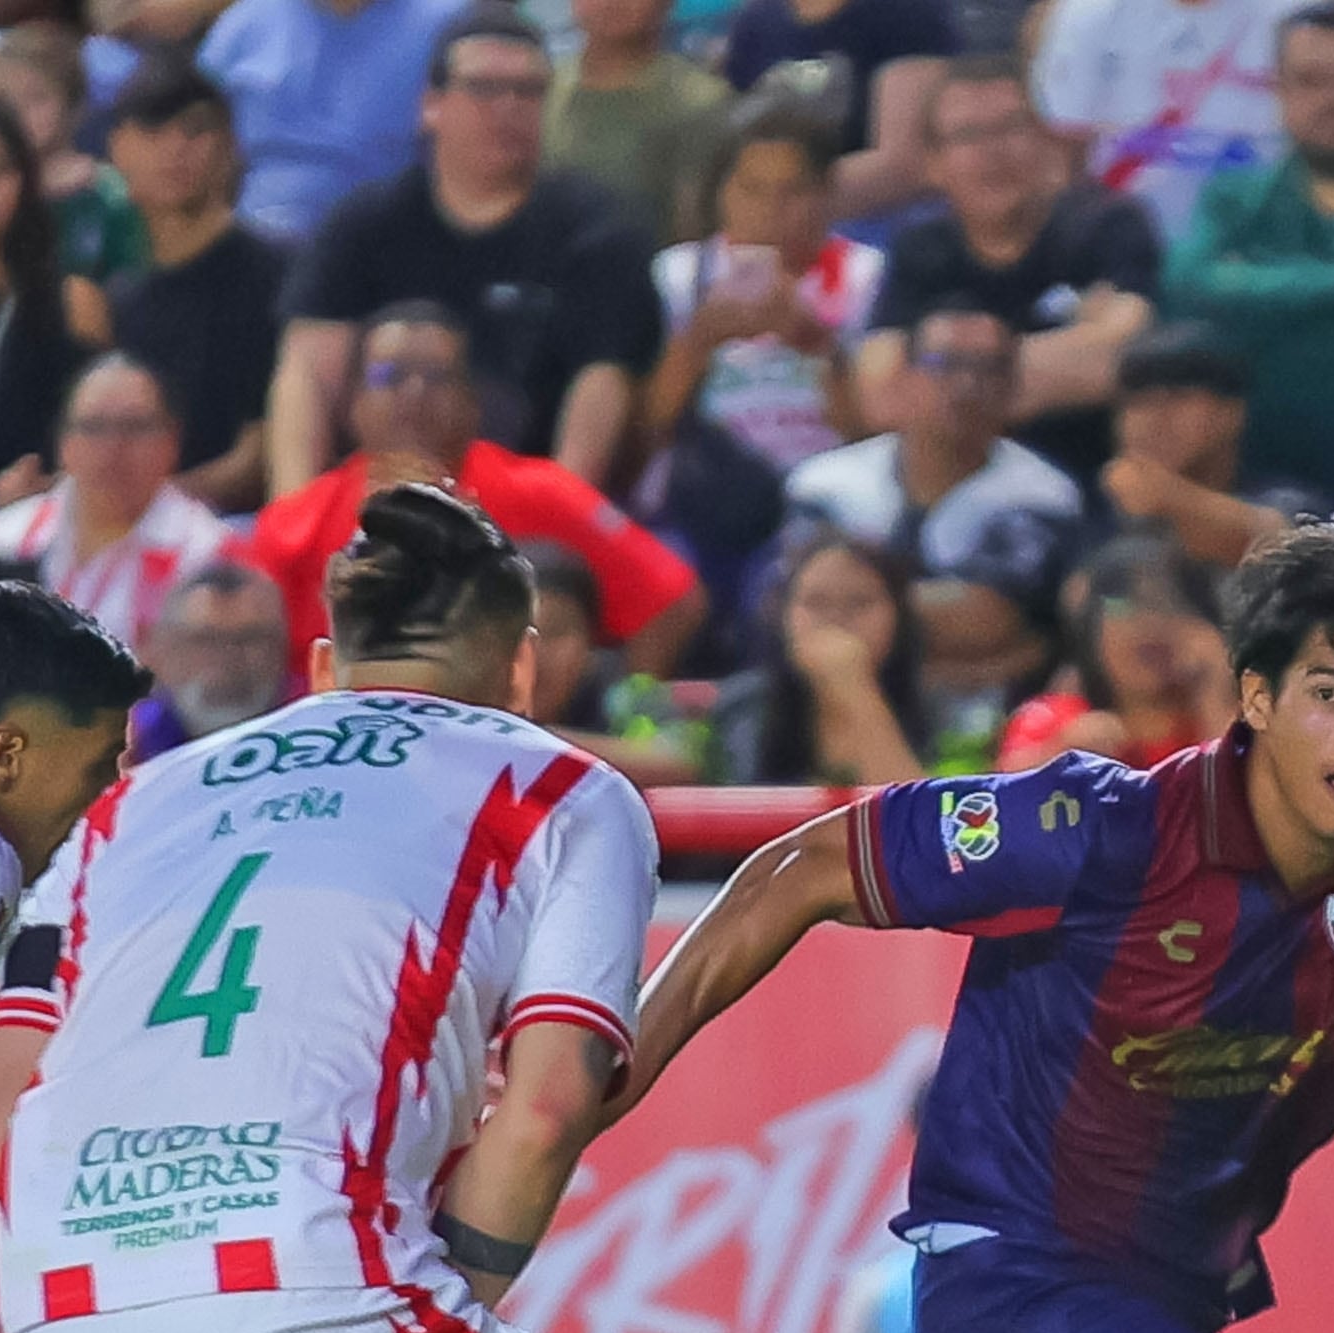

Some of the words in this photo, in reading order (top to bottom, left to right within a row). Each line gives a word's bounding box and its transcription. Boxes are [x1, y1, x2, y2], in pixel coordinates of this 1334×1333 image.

[144, 852, 273, 1058] 4
[64, 1151, 281, 1211] MADERAS
[60, 1204, 174, 1235] TERRENOS
[202, 1191, 280, 1213] CASAS
[114, 1218, 218, 1248] PREMIUM
